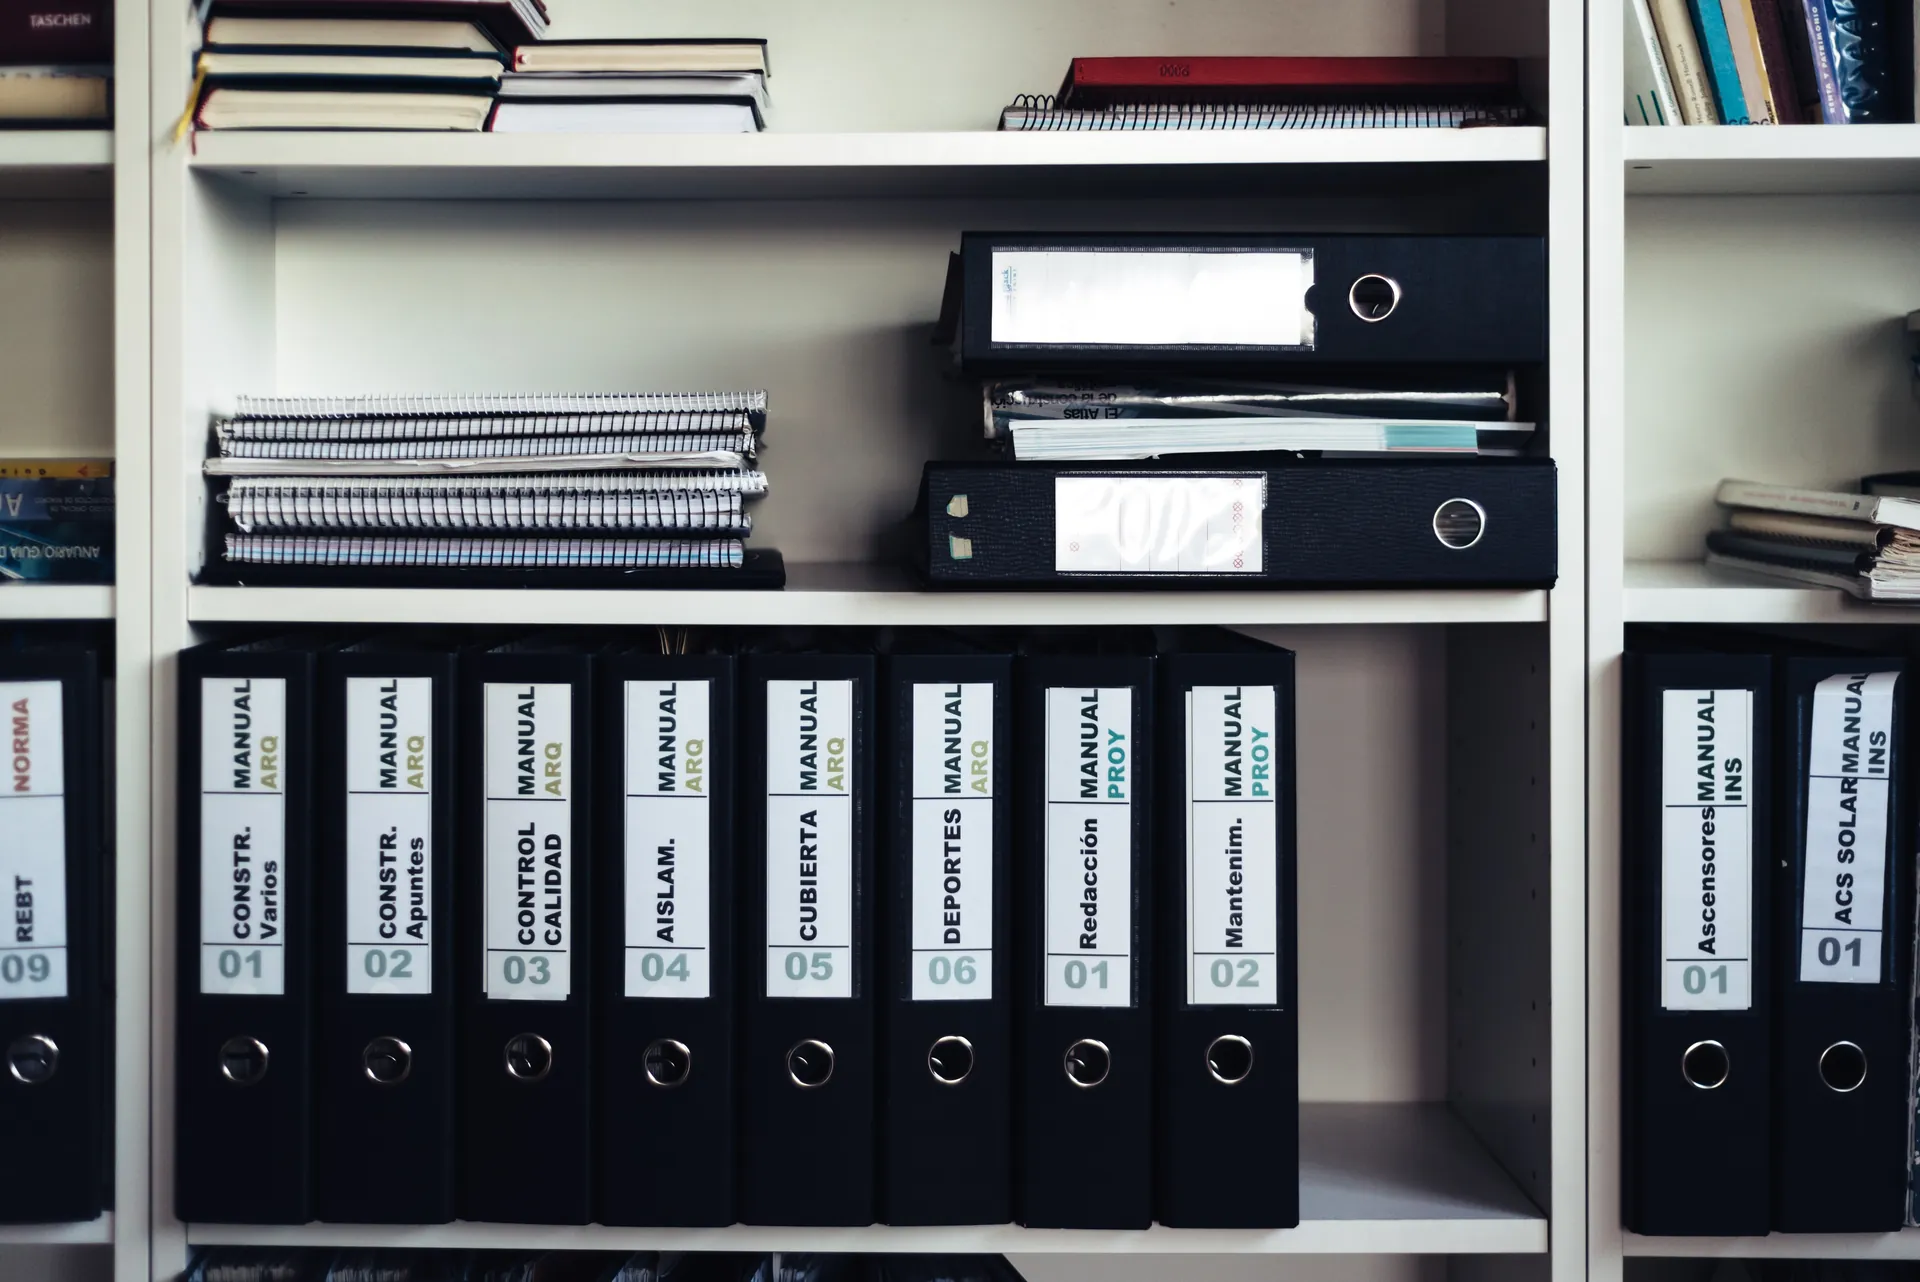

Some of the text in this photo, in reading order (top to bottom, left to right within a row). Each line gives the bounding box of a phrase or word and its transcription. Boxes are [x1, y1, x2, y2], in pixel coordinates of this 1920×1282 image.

[30, 13, 91, 27] TASCHEN
[1812, 6, 1828, 68] PATRIMONIO
[1825, 83, 1836, 114] RENTA
[1064, 407, 1118, 419] El Atlas
[1081, 392, 1095, 404] la
[1101, 392, 1117, 405] de
[13, 699, 30, 792] NORMA
[233, 679, 251, 788] MANUAL
[380, 679, 397, 788] MANUAL
[518, 686, 535, 795] MANUAL
[659, 682, 676, 792] MANUAL
[800, 681, 817, 790] MANUAL
[944, 684, 961, 793] MANUAL
[1080, 688, 1098, 798] MANUAL
[1224, 687, 1241, 796] MANUAL
[1698, 690, 1715, 801] MANUAL
[1841, 673, 1869, 773] MANUAL
[1868, 731, 1886, 774] INS
[260, 736, 277, 789] ARQ
[407, 736, 424, 788] ARQ
[545, 743, 562, 796] ARQ
[685, 740, 703, 792] ARQ
[827, 738, 845, 791] ARQ
[971, 741, 988, 794] ARQ
[1108, 729, 1125, 798] PROY
[1252, 727, 1269, 796] PROY
[1725, 758, 1742, 800] INS
[233, 827, 251, 939] CONSTR.
[379, 827, 396, 938] CONSTR.
[518, 822, 535, 945] CONTROL
[800, 810, 817, 941] CUBIERTA
[944, 809, 961, 944] DEPORTES
[1080, 819, 1097, 949] Redacción
[1225, 818, 1242, 947] Mantenim.
[1698, 806, 1715, 955] Ascensores
[1835, 777, 1859, 924] ACS SOLAR
[15, 876, 33, 942] REBT
[260, 861, 277, 939] Varios
[406, 838, 427, 939] Apuntes
[544, 834, 561, 945] CALIDAD
[657, 839, 674, 943] AISLAM.
[1, 953, 50, 983] 09
[219, 950, 261, 978] 01
[364, 949, 412, 978] 02
[504, 956, 550, 984] 03
[642, 953, 690, 981] 04
[785, 952, 833, 980] 05
[929, 956, 976, 984] 06
[1064, 960, 1107, 989] 01
[1211, 959, 1259, 987] 02
[1683, 965, 1727, 994] 01
[1818, 937, 1861, 966] 01
